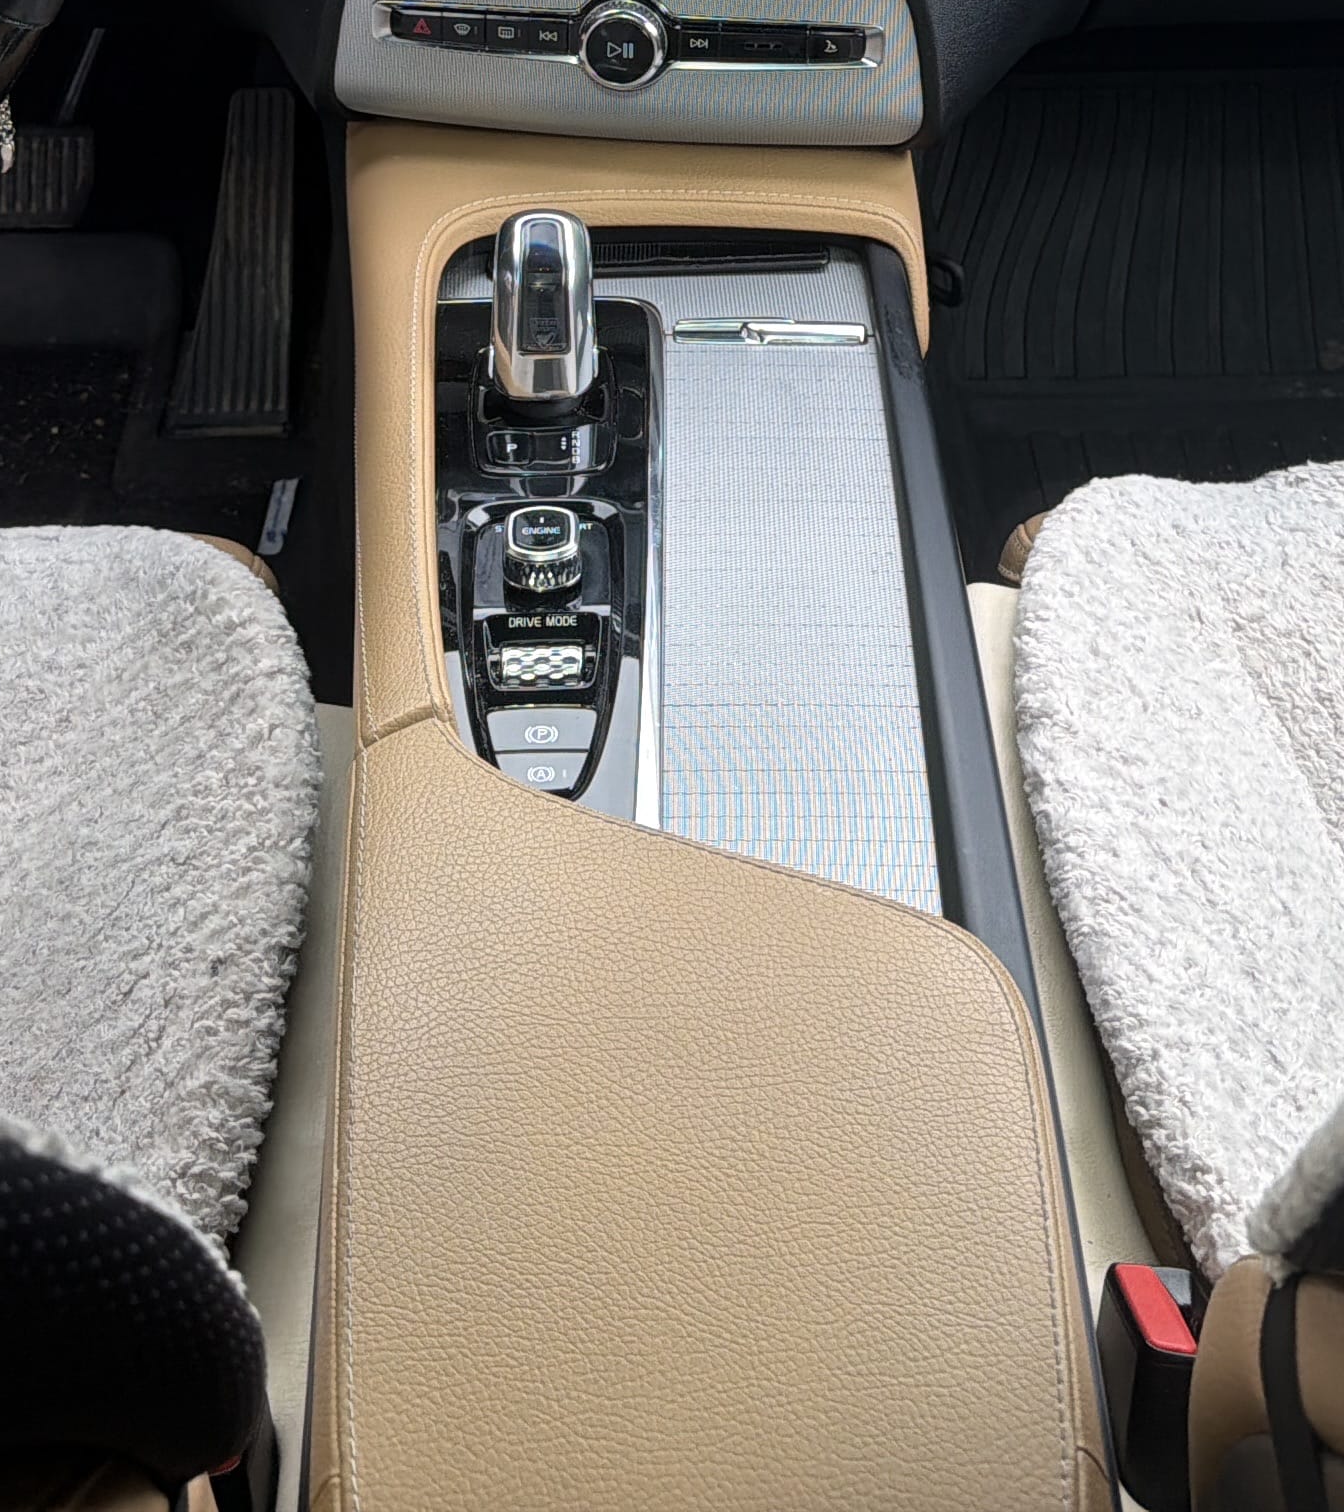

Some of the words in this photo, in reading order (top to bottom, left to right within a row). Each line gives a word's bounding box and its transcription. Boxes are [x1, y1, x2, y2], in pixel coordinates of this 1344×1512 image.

[506, 443, 518, 453] P
[522, 526, 561, 535] ENGINE
[508, 616, 542, 628] DRIVE
[546, 615, 578, 627] MODE
